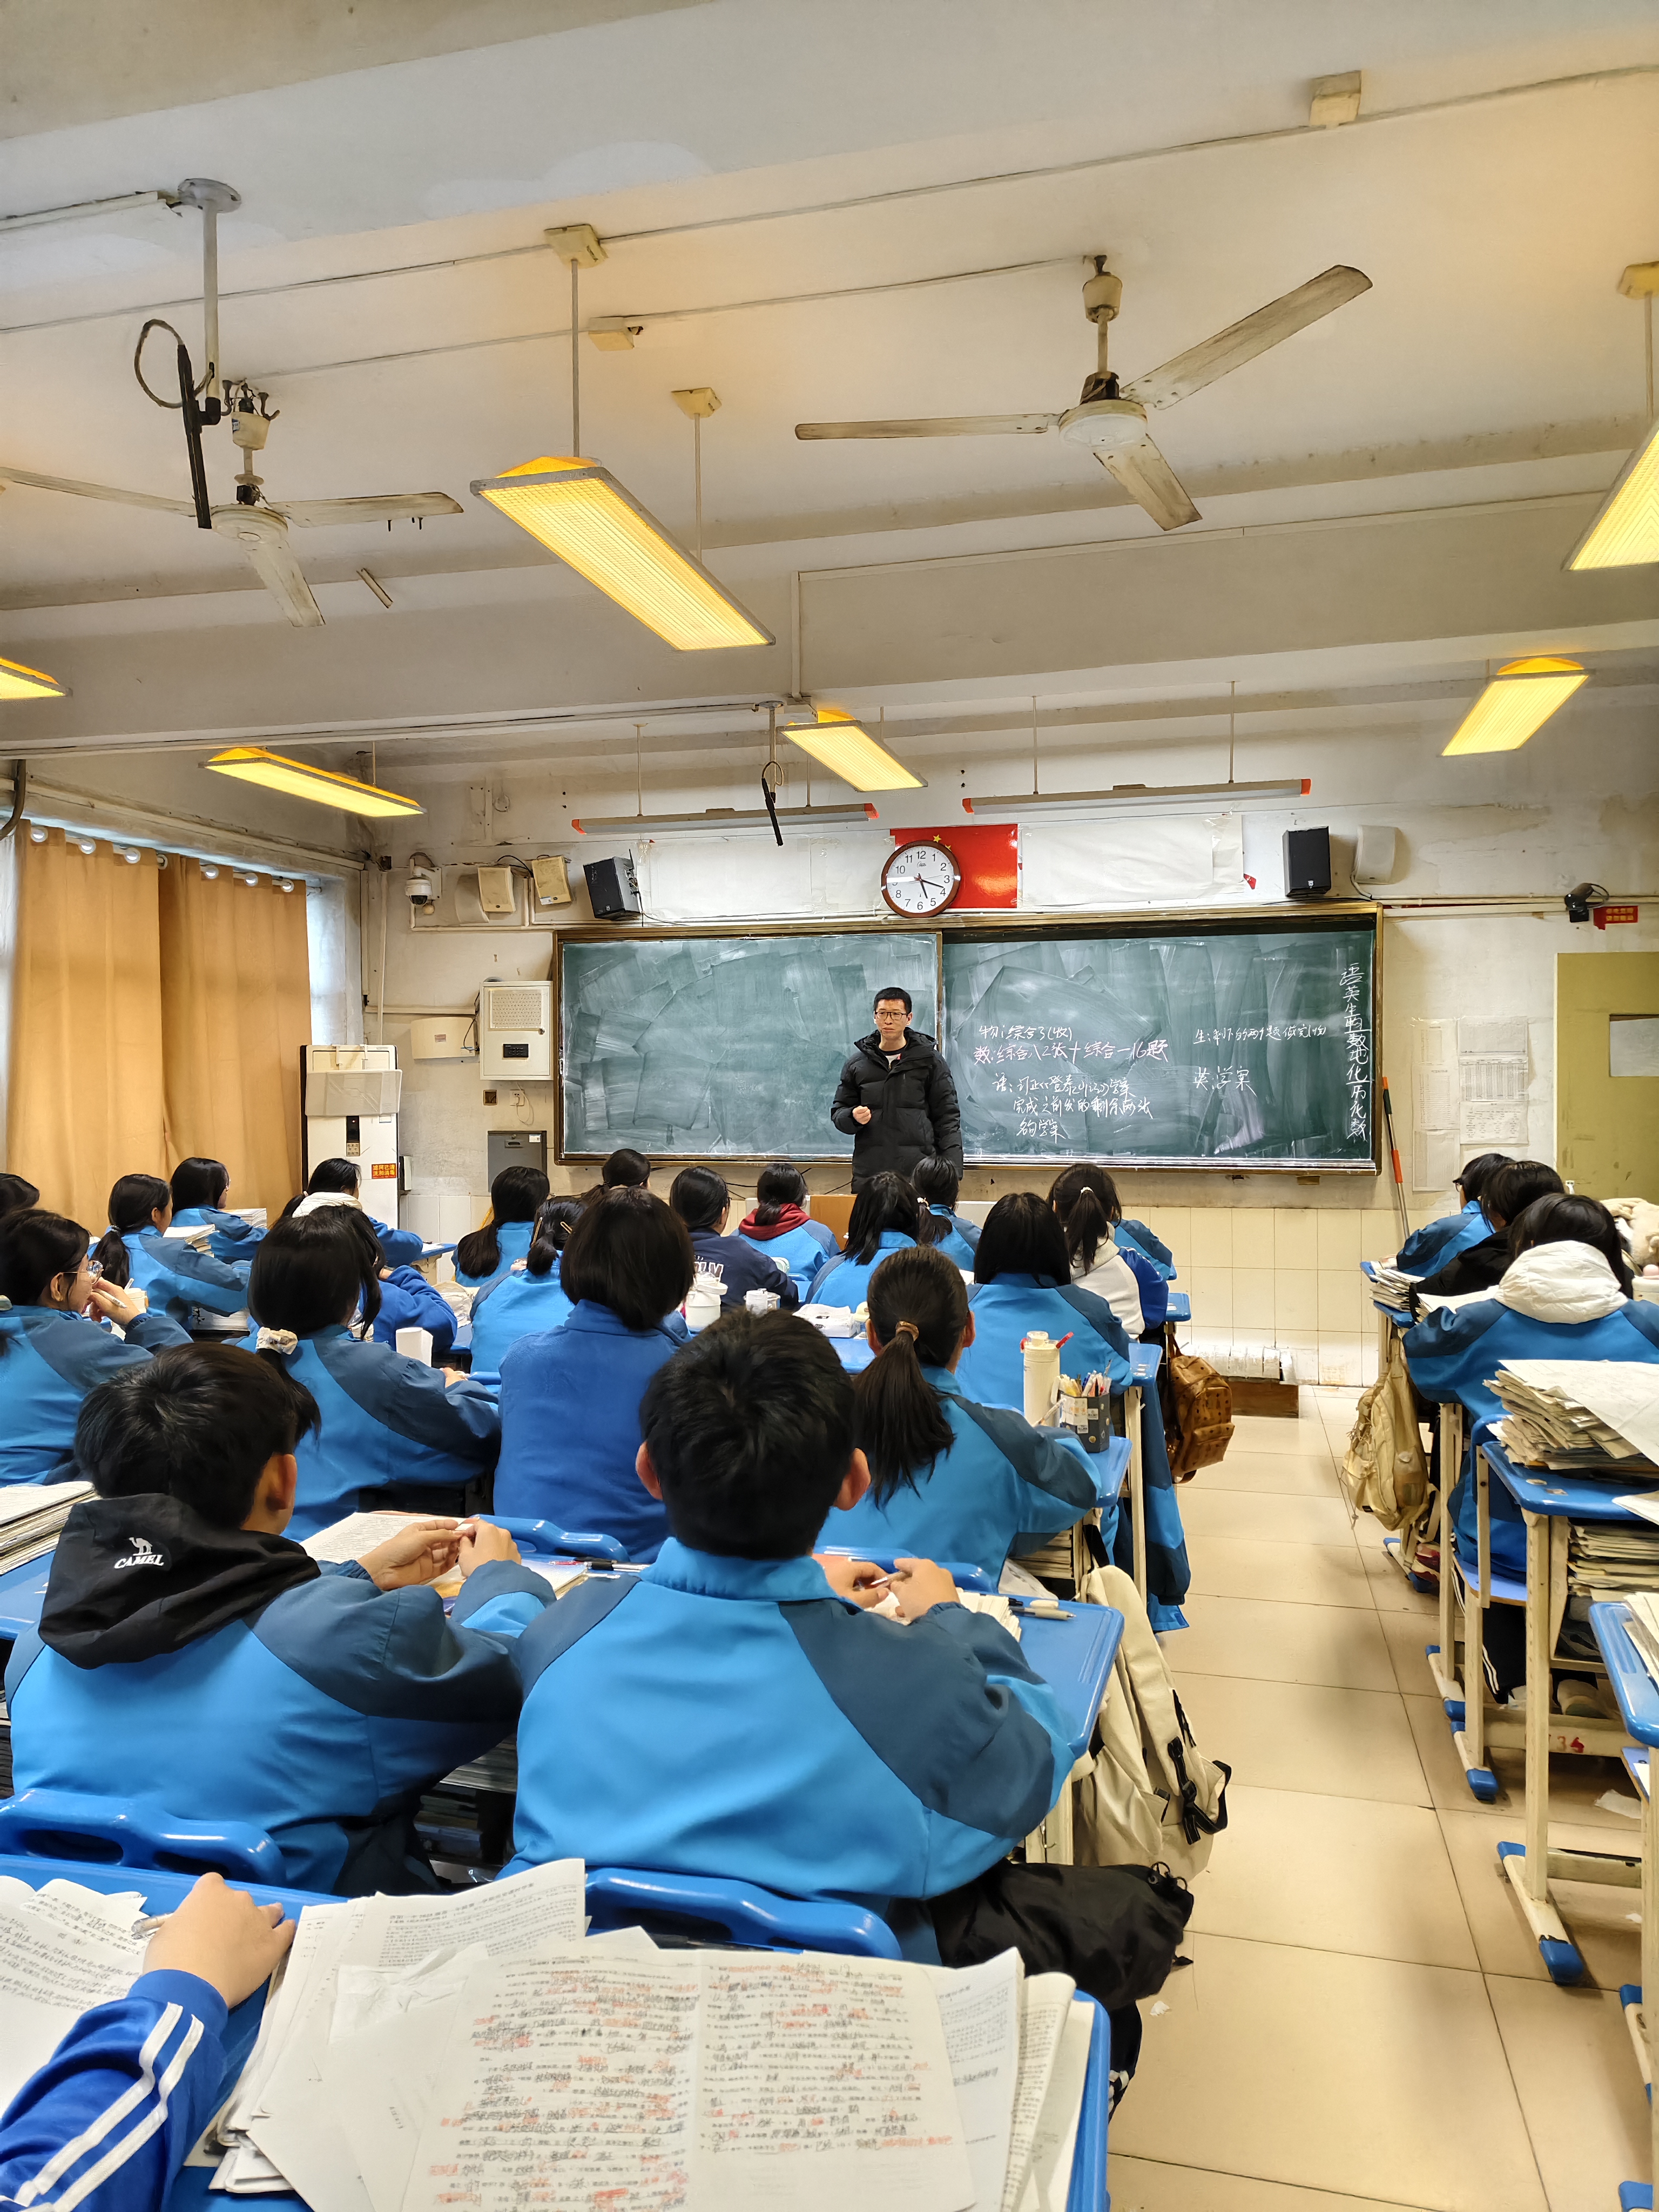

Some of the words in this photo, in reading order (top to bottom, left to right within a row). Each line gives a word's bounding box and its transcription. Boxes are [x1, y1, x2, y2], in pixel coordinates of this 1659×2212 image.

[905, 855, 913, 863] 11
[916, 851, 926, 859] 12
[932, 853, 936, 862] 1
[896, 865, 906, 874] 10
[940, 862, 947, 871] 2
[943, 875, 950, 884] 3
[895, 890, 901, 898] 8
[940, 888, 946, 896] 4
[905, 899, 911, 907] 7
[917, 902, 923, 910] 6
[930, 898, 936, 906] 5
[114, 1554, 164, 1569] CAMEL
